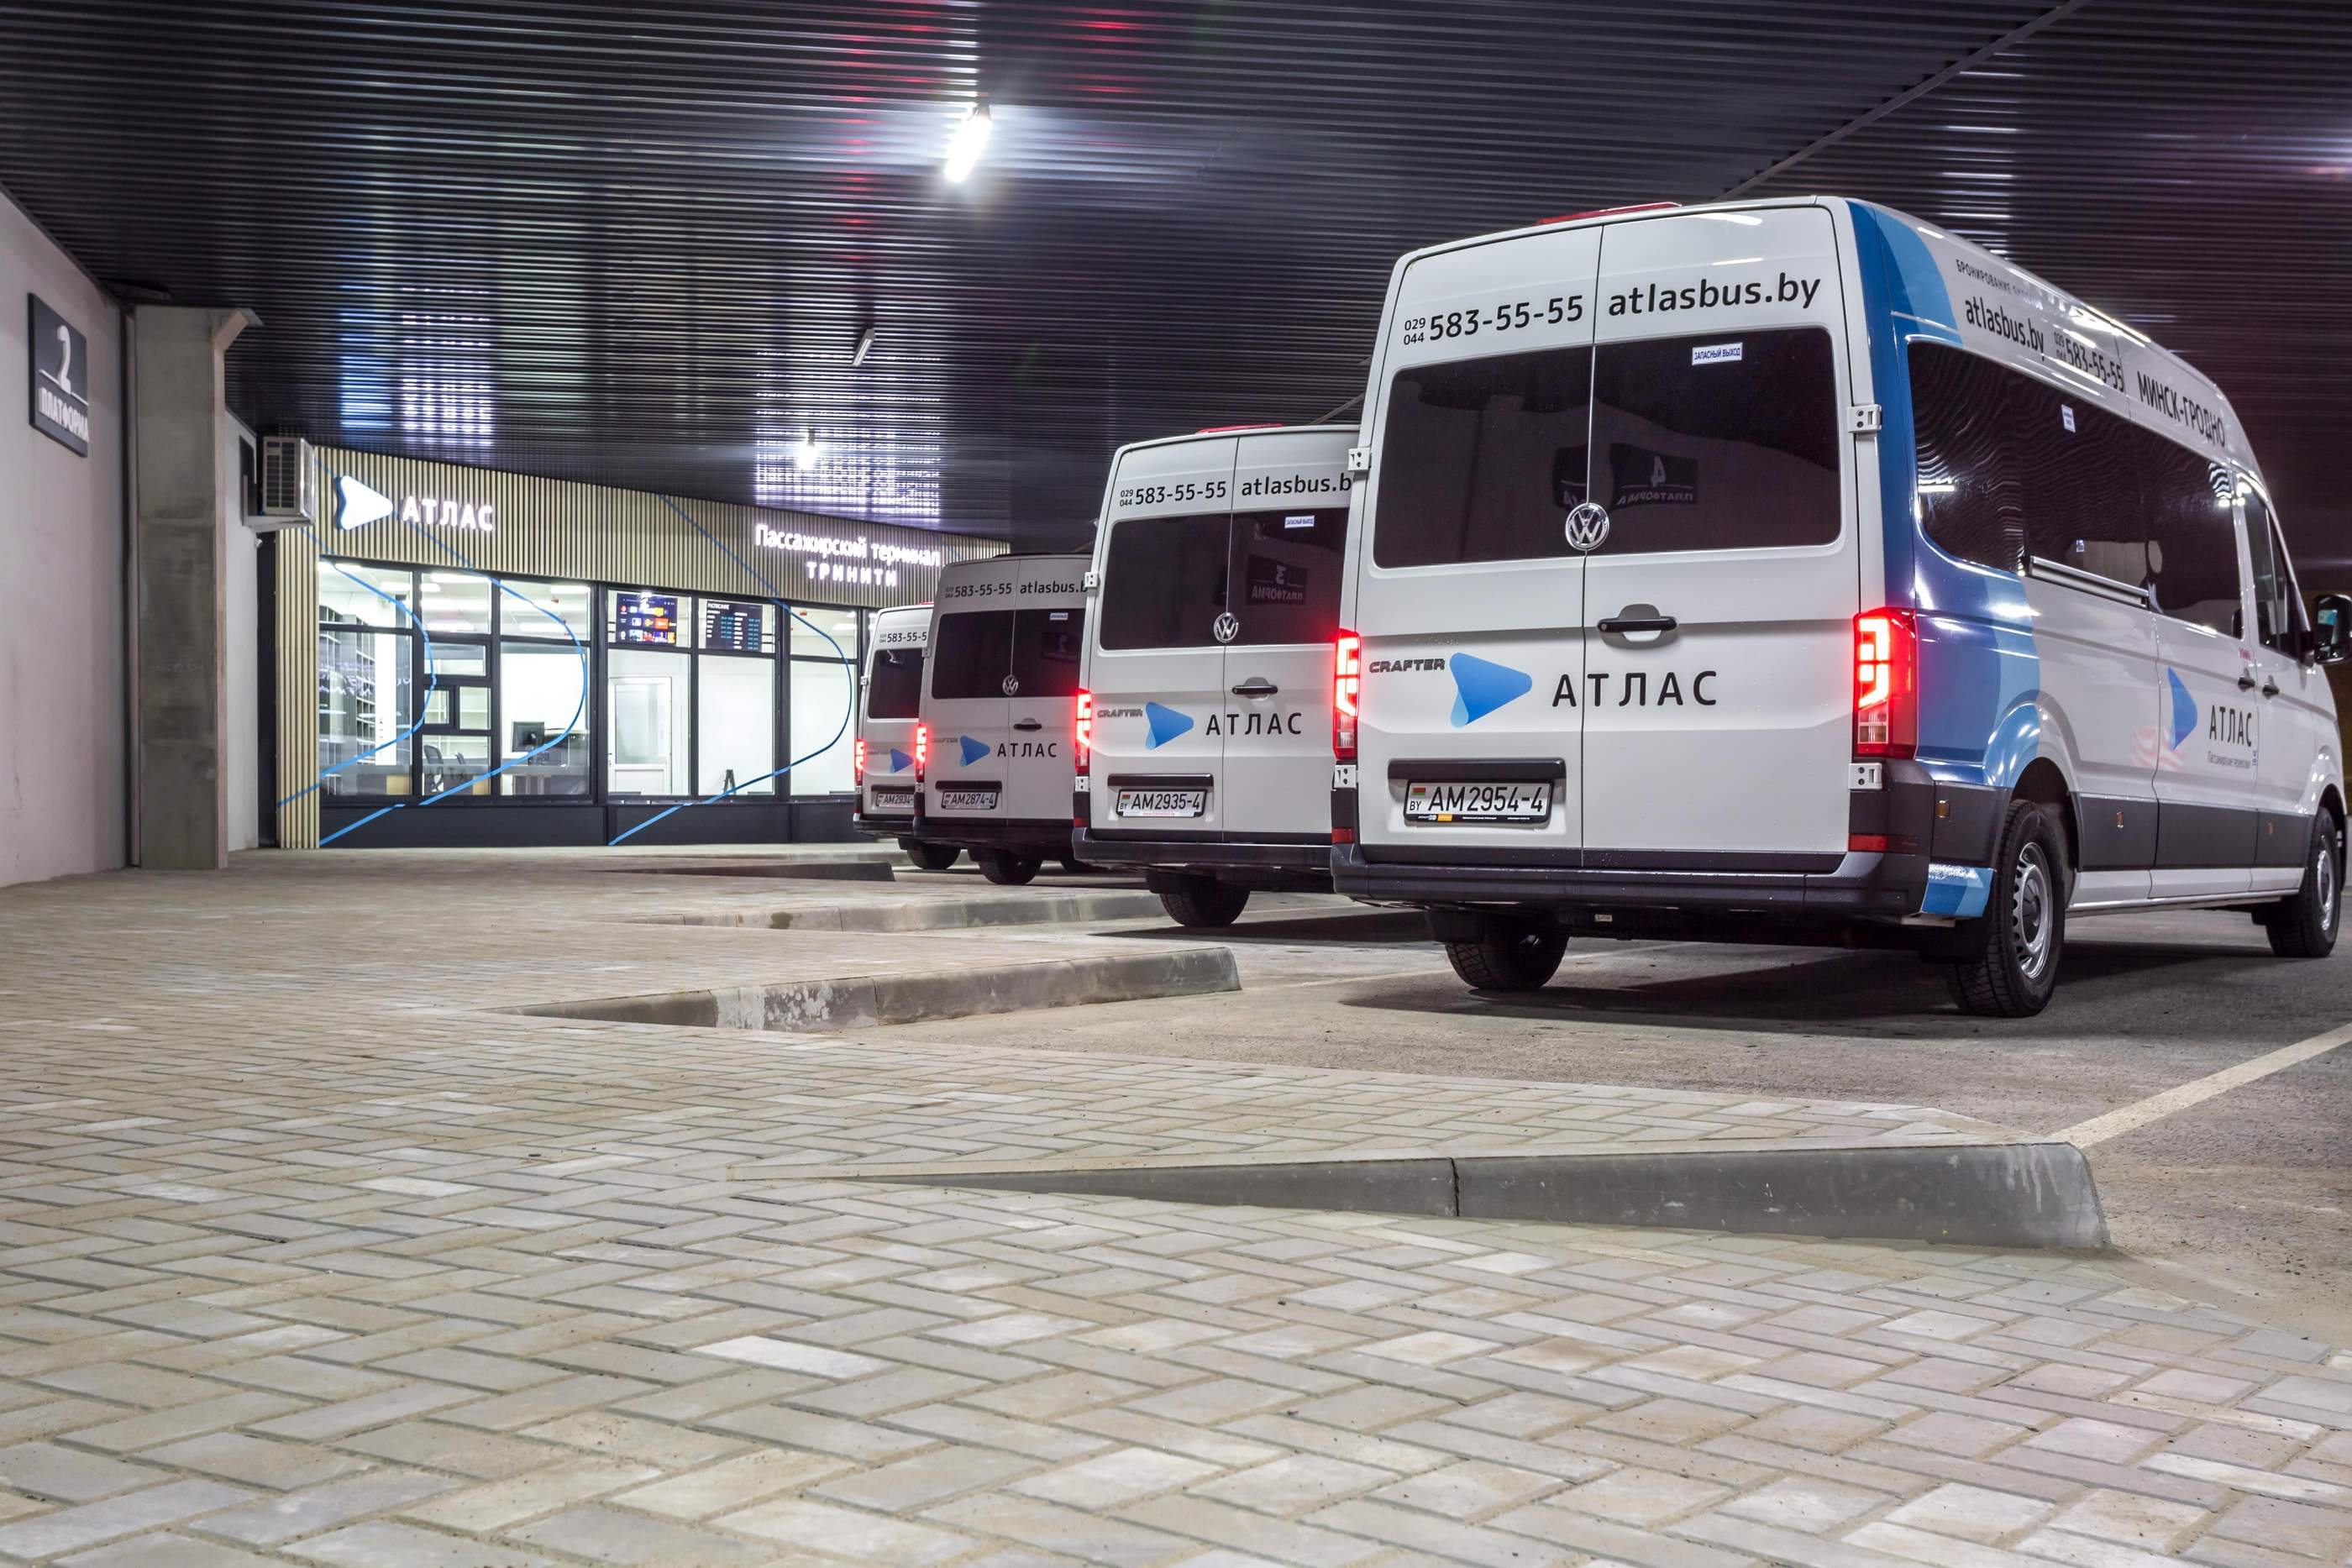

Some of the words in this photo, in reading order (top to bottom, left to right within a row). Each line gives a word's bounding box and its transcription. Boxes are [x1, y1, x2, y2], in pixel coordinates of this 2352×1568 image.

[1430, 294, 1584, 341] 583-55-55
[1608, 272, 1821, 317] atlasbus.by
[1404, 317, 1425, 331] 029
[1404, 332, 1425, 345] 044
[1964, 296, 2045, 361] atlasbus.by
[2066, 338, 2124, 392] 583-55-55
[57, 325, 72, 396] 2
[1694, 349, 1721, 360] ЗАПАСНЫЙ
[1723, 347, 1740, 358] ВЫХОД
[39, 386, 89, 443] ПЛАТФОРМА
[2137, 370, 2225, 448] МИНСК-ГРОДНО
[1121, 490, 1134, 498] 029
[1135, 480, 1226, 505] 583-55-55
[1242, 472, 1352, 496] atlasbus.b
[402, 496, 493, 532] АТЛАС
[755, 523, 867, 559] Пассажирский
[871, 543, 940, 567] терминал
[806, 561, 897, 587] ТРИНИТИ
[954, 583, 1012, 597] 583-55-55
[1020, 579, 1088, 594] atlasbus.b
[887, 632, 927, 642] 583-55-5
[1369, 658, 1445, 673] CRAFTER
[1551, 670, 1718, 708] АТЛАС
[1206, 712, 1302, 735] АТЛАС
[2209, 705, 2252, 747] АТЛАС
[997, 742, 1058, 758] АТЛАС
[883, 795, 914, 804] AM2934-
[951, 794, 993, 805] AM2874-4
[1131, 794, 1200, 810] AM2935-4
[1410, 800, 1421, 811] BY
[1428, 786, 1543, 812] AM2954-4
